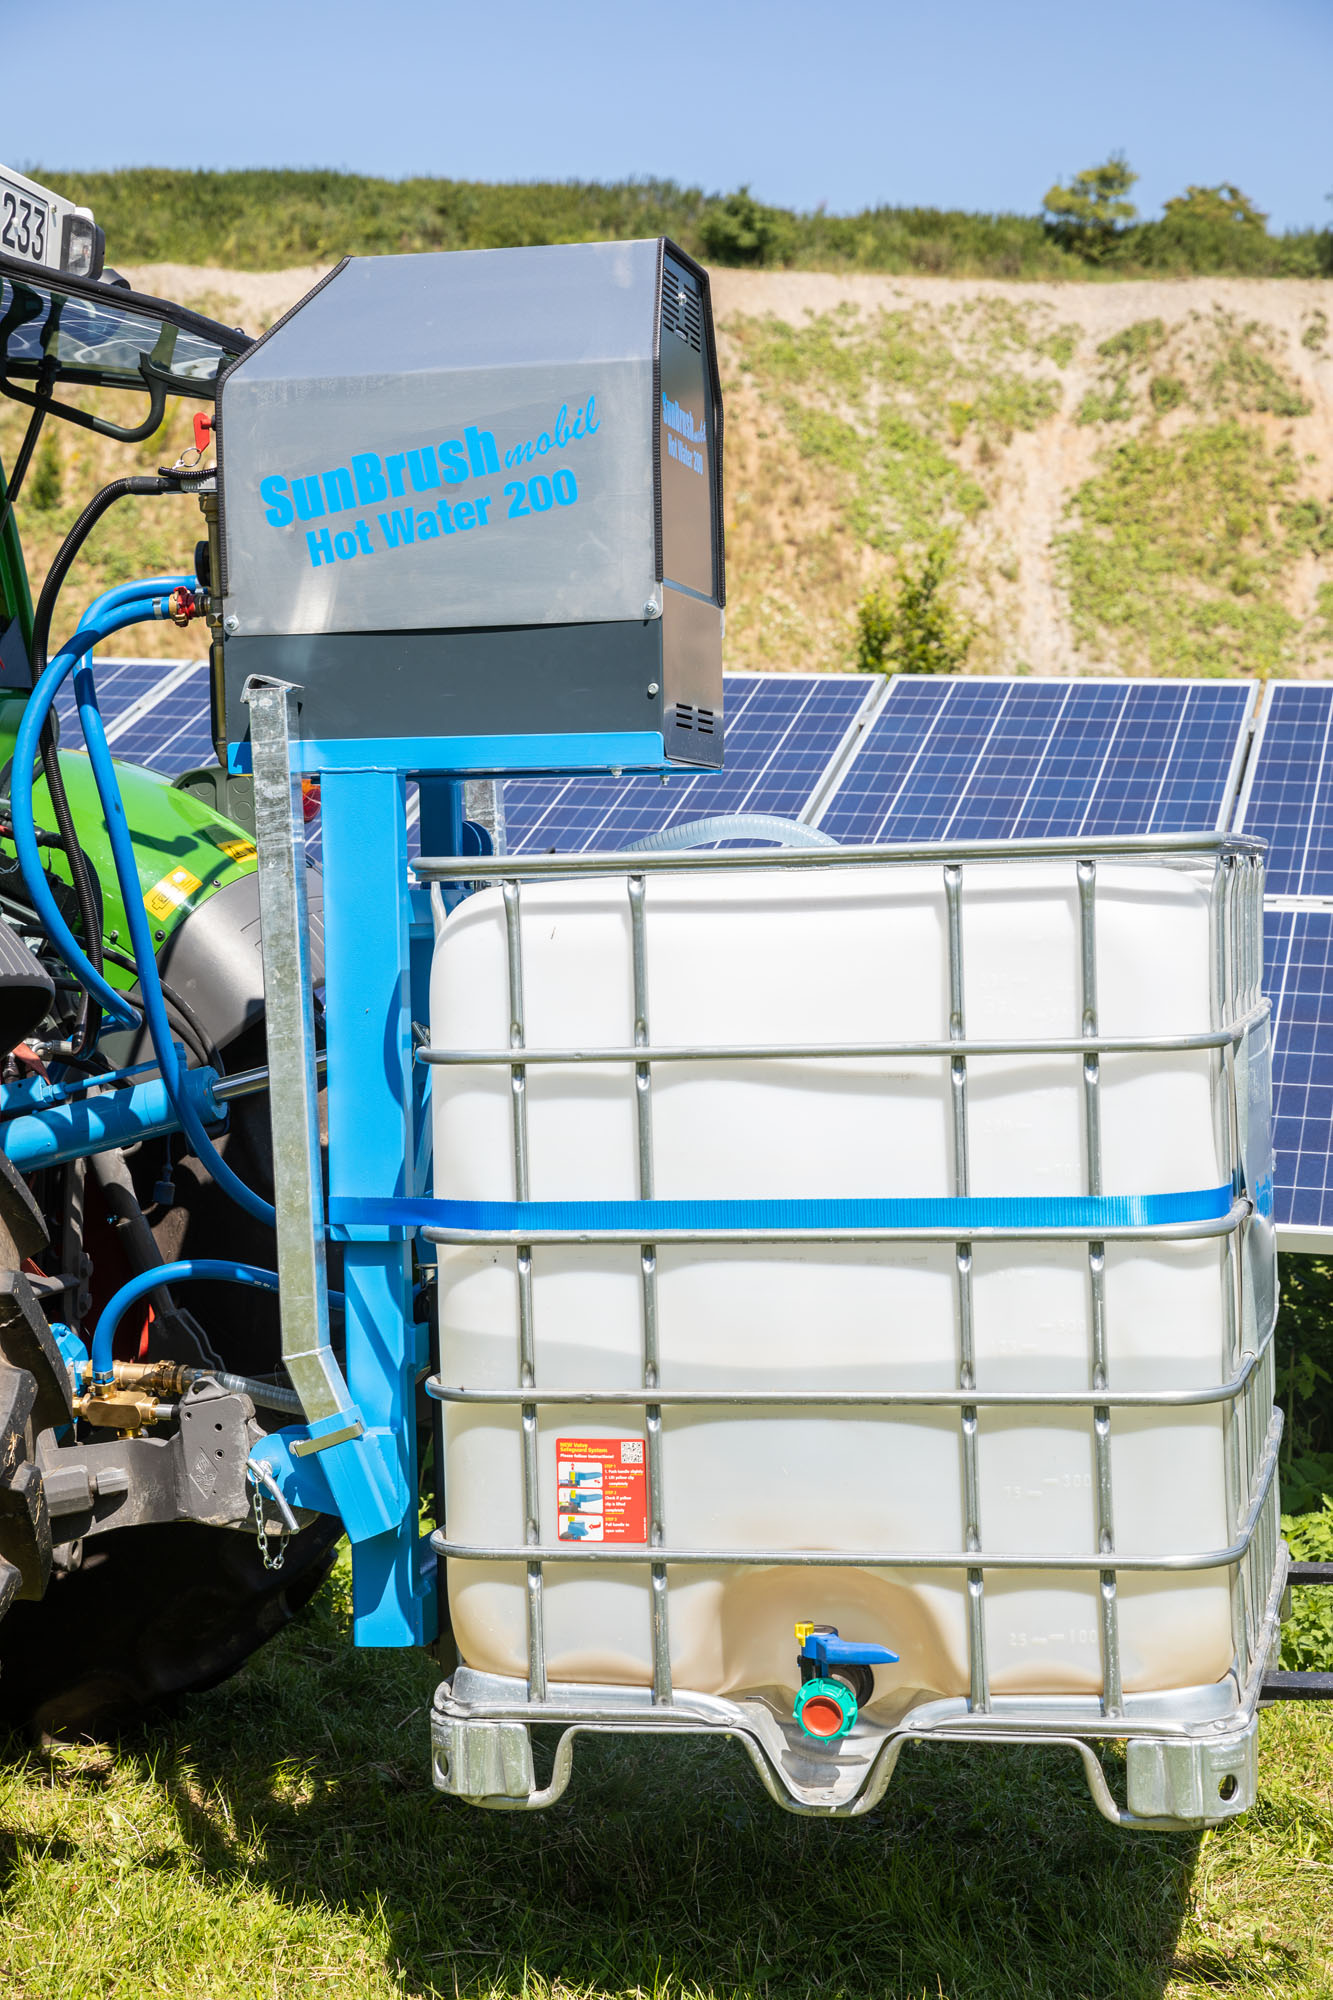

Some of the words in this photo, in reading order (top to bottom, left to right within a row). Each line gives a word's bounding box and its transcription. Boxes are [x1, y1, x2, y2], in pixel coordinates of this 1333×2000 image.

[2, 191, 45, 260] 233
[260, 426, 501, 527] SunBrush
[504, 395, 600, 469] mobil
[306, 520, 374, 567] Hot
[377, 496, 492, 548] Water
[504, 469, 578, 519] 200
